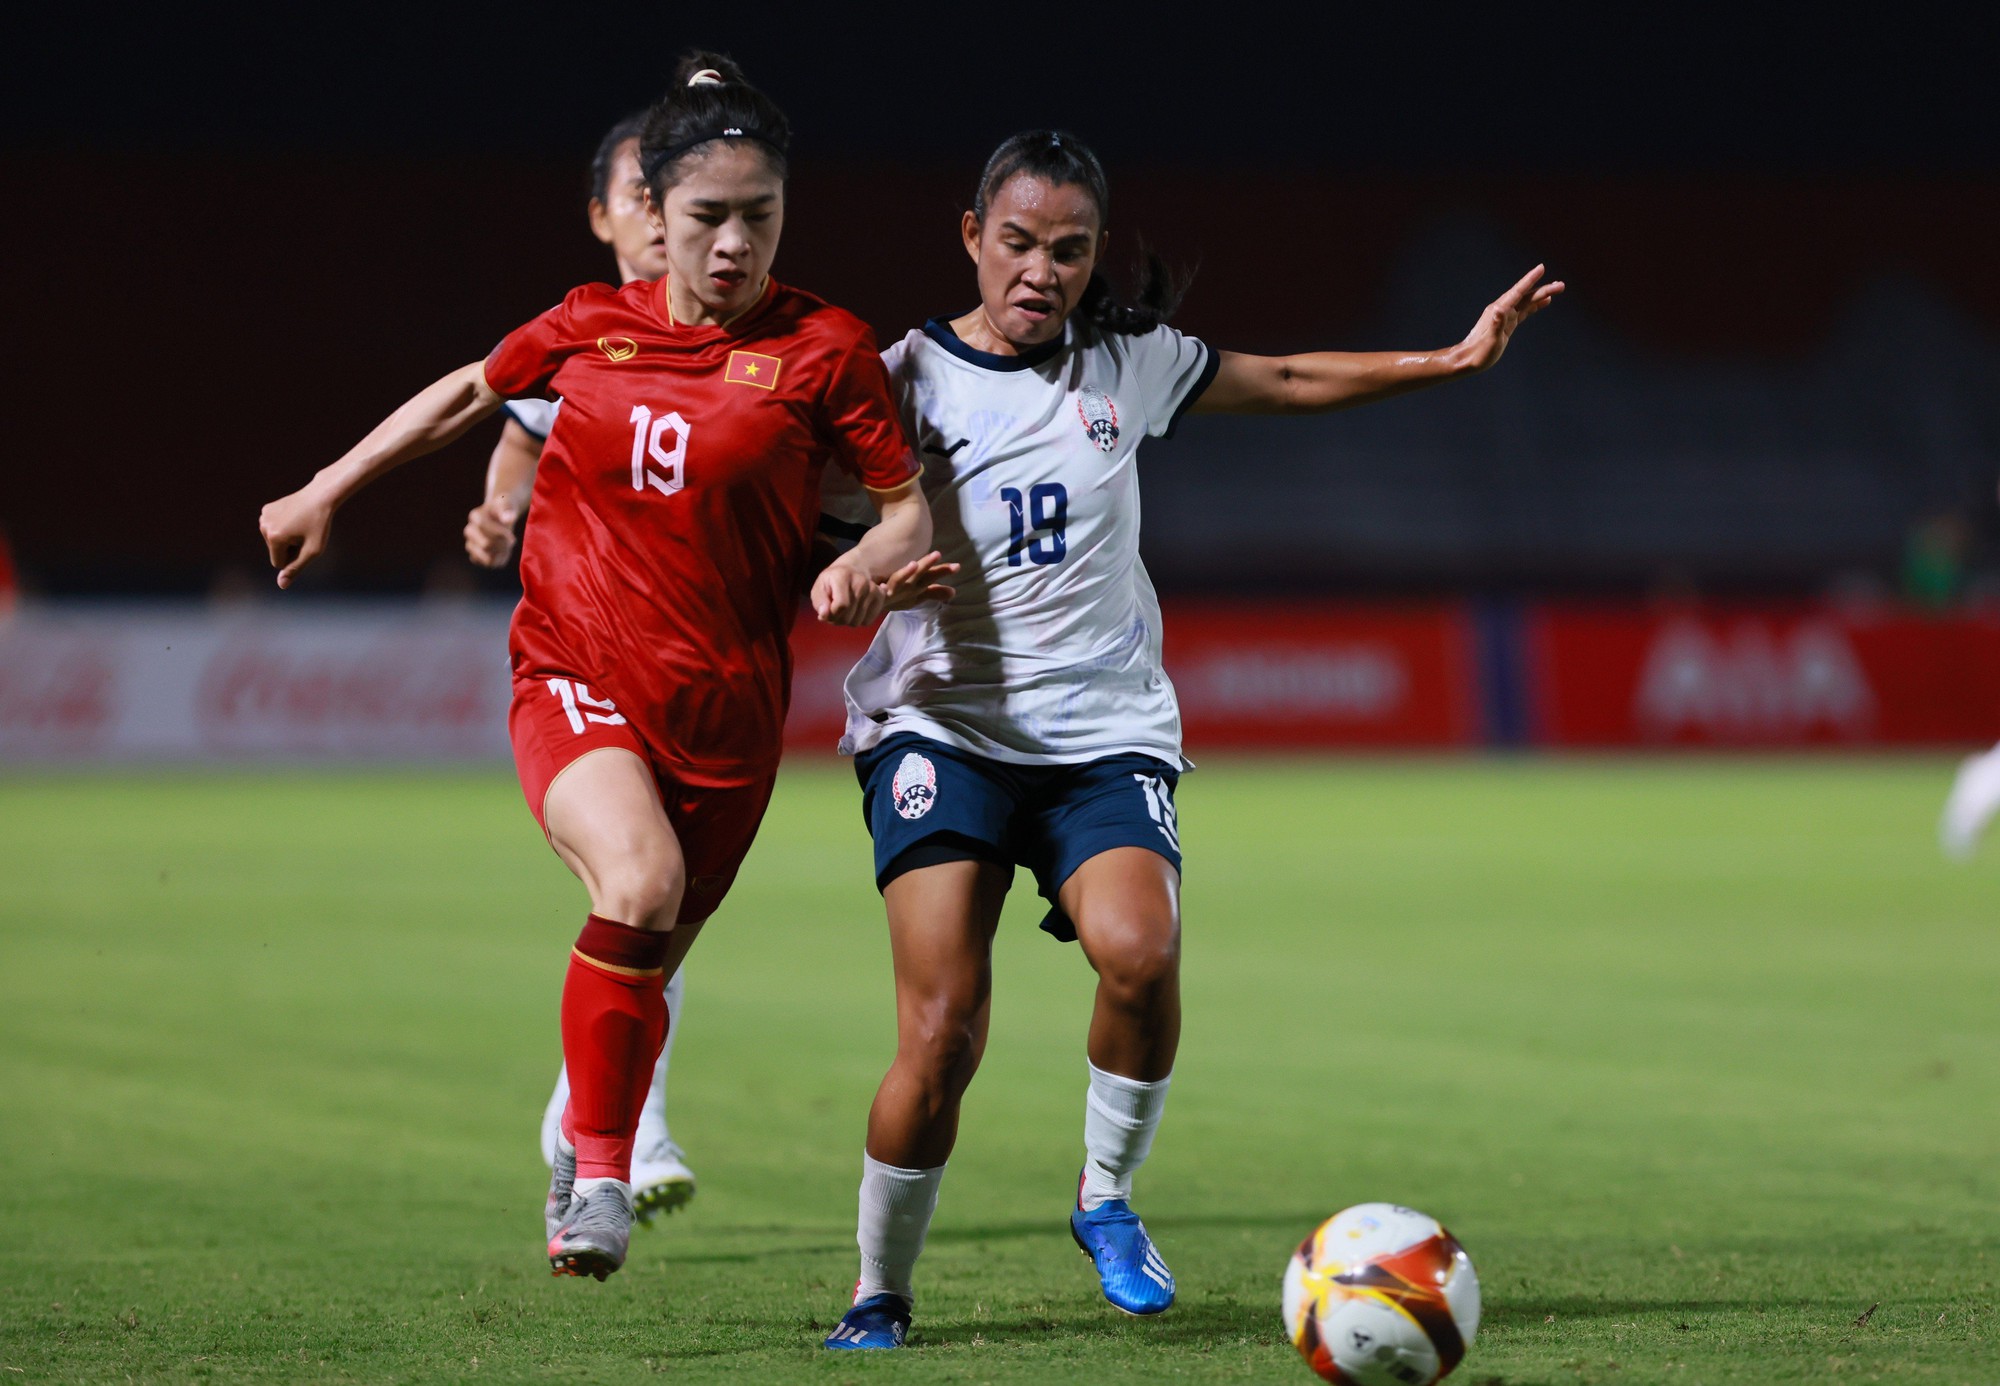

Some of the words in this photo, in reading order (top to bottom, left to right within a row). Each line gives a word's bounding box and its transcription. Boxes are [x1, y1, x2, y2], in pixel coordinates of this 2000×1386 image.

[629, 404, 692, 497] 19
[1092, 421, 1112, 433] FFC
[1000, 482, 1068, 567] 19
[903, 786, 926, 801] FFC
